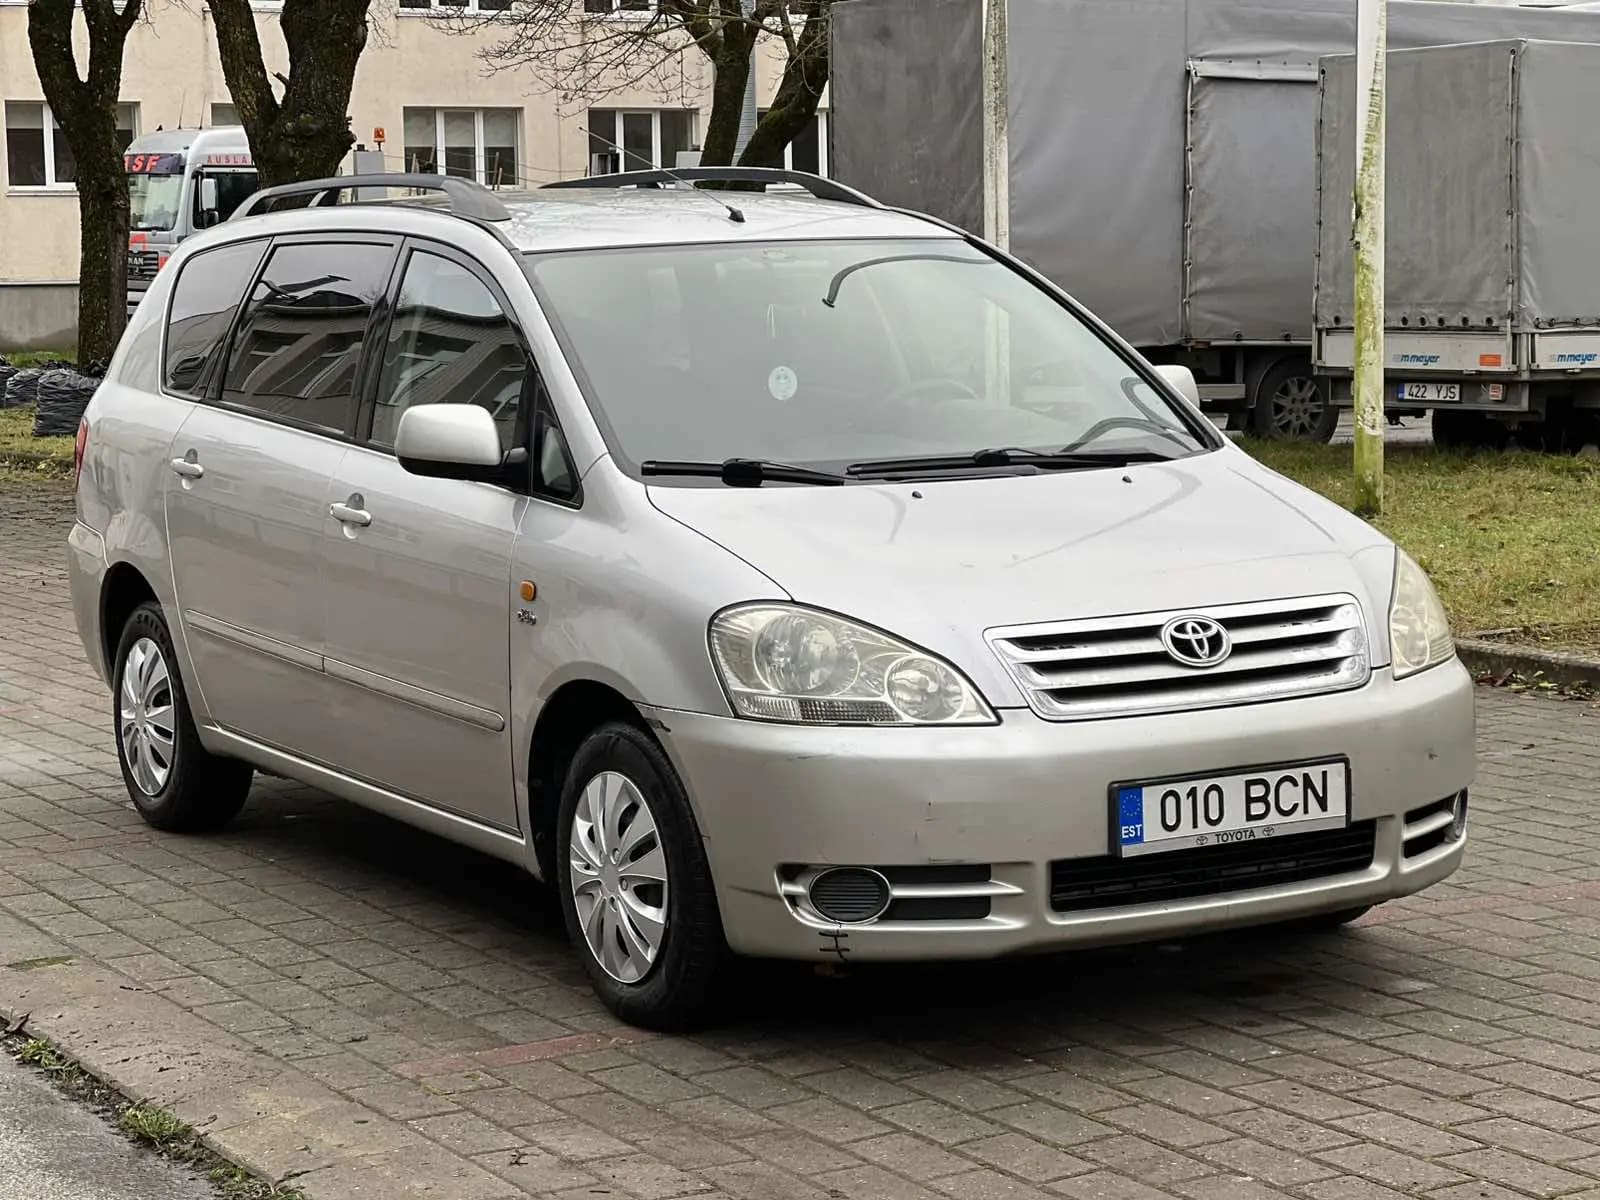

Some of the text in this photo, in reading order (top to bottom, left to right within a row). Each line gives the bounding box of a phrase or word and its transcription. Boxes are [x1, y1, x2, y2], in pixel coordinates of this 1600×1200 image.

[1408, 384, 1427, 398] 422
[1436, 384, 1456, 399] YJS
[1160, 770, 1328, 832] 010 BCN
[1121, 823, 1143, 839] EST
[1215, 830, 1256, 844] TOYOTA
